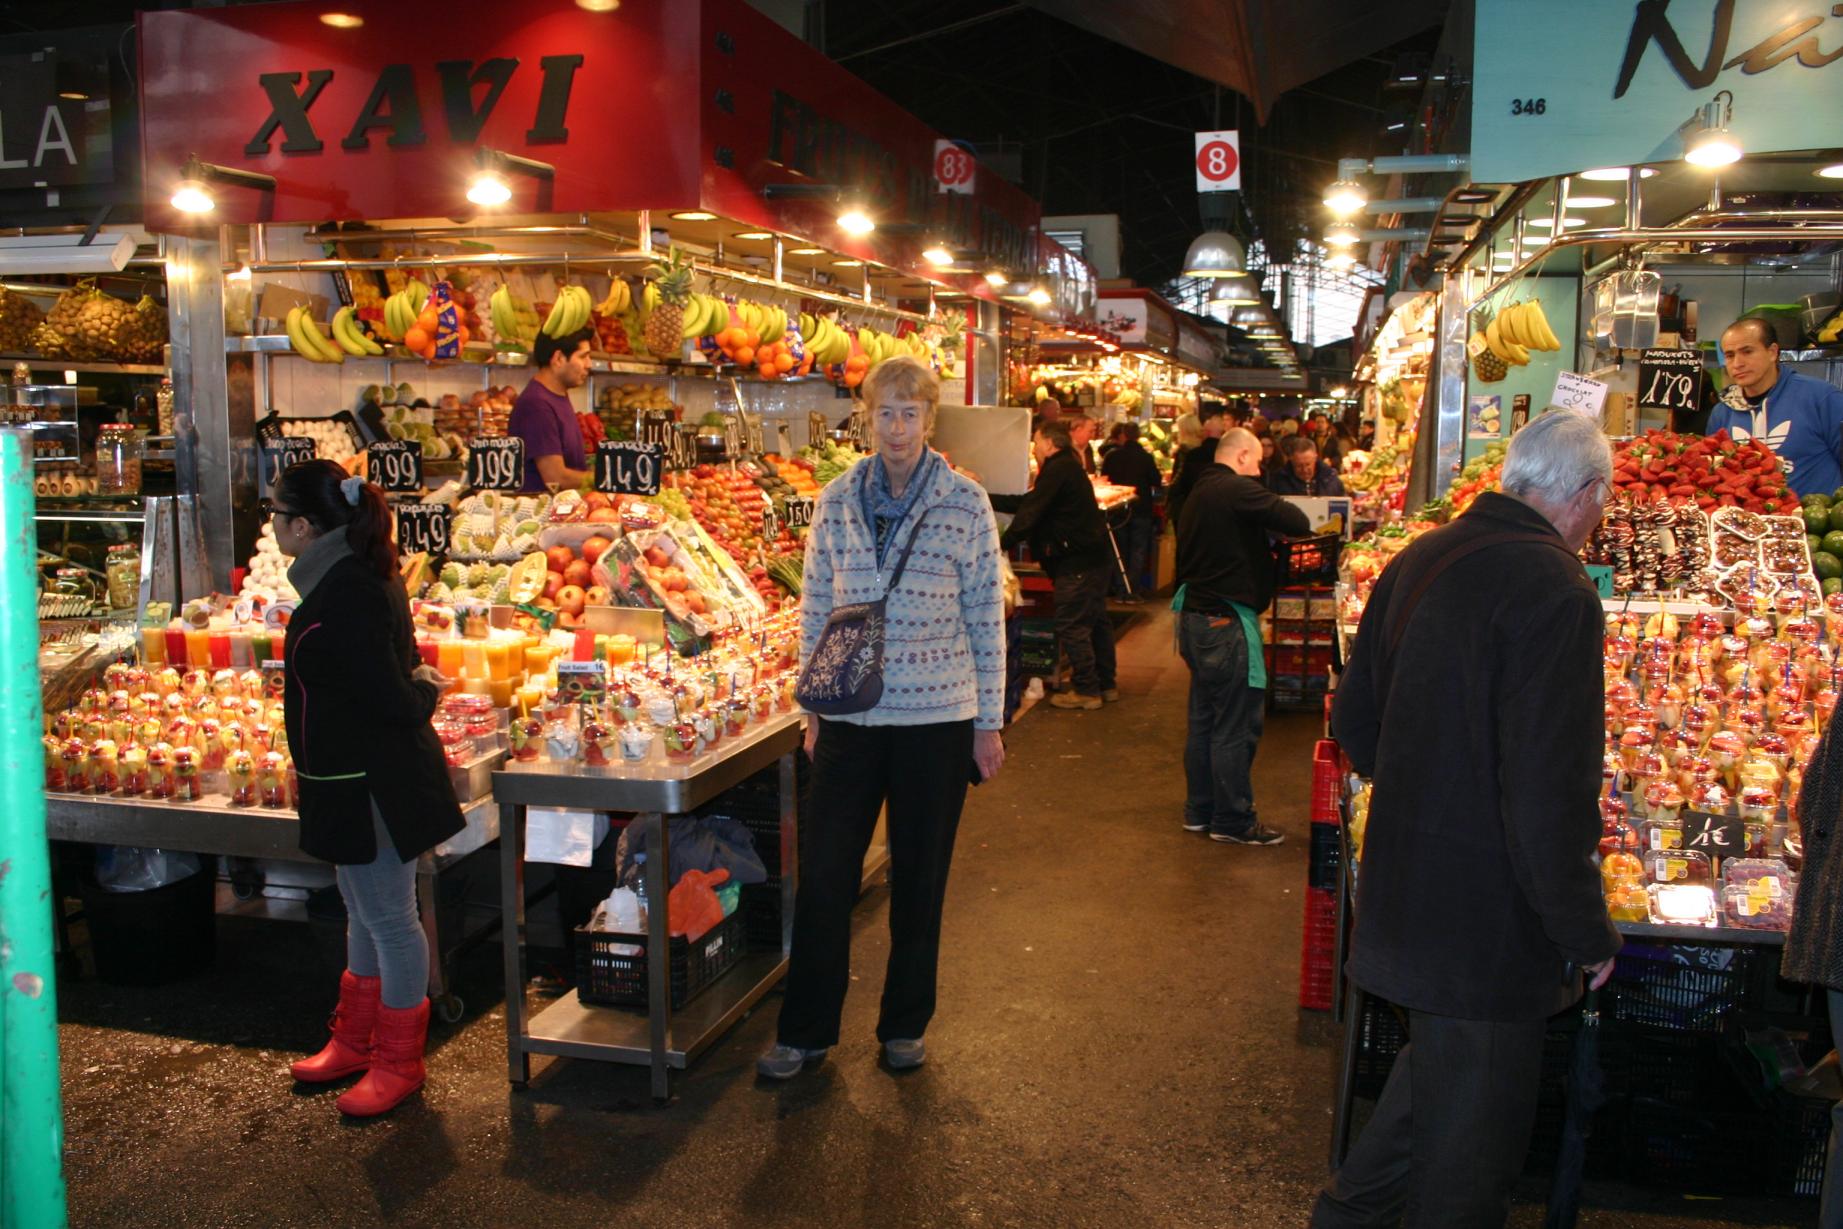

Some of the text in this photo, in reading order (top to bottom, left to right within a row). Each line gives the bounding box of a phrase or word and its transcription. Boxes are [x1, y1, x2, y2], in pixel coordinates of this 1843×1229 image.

[245, 54, 584, 156] XAVI
[1512, 98, 1546, 115] 346
[1208, 148, 1227, 175] 8
